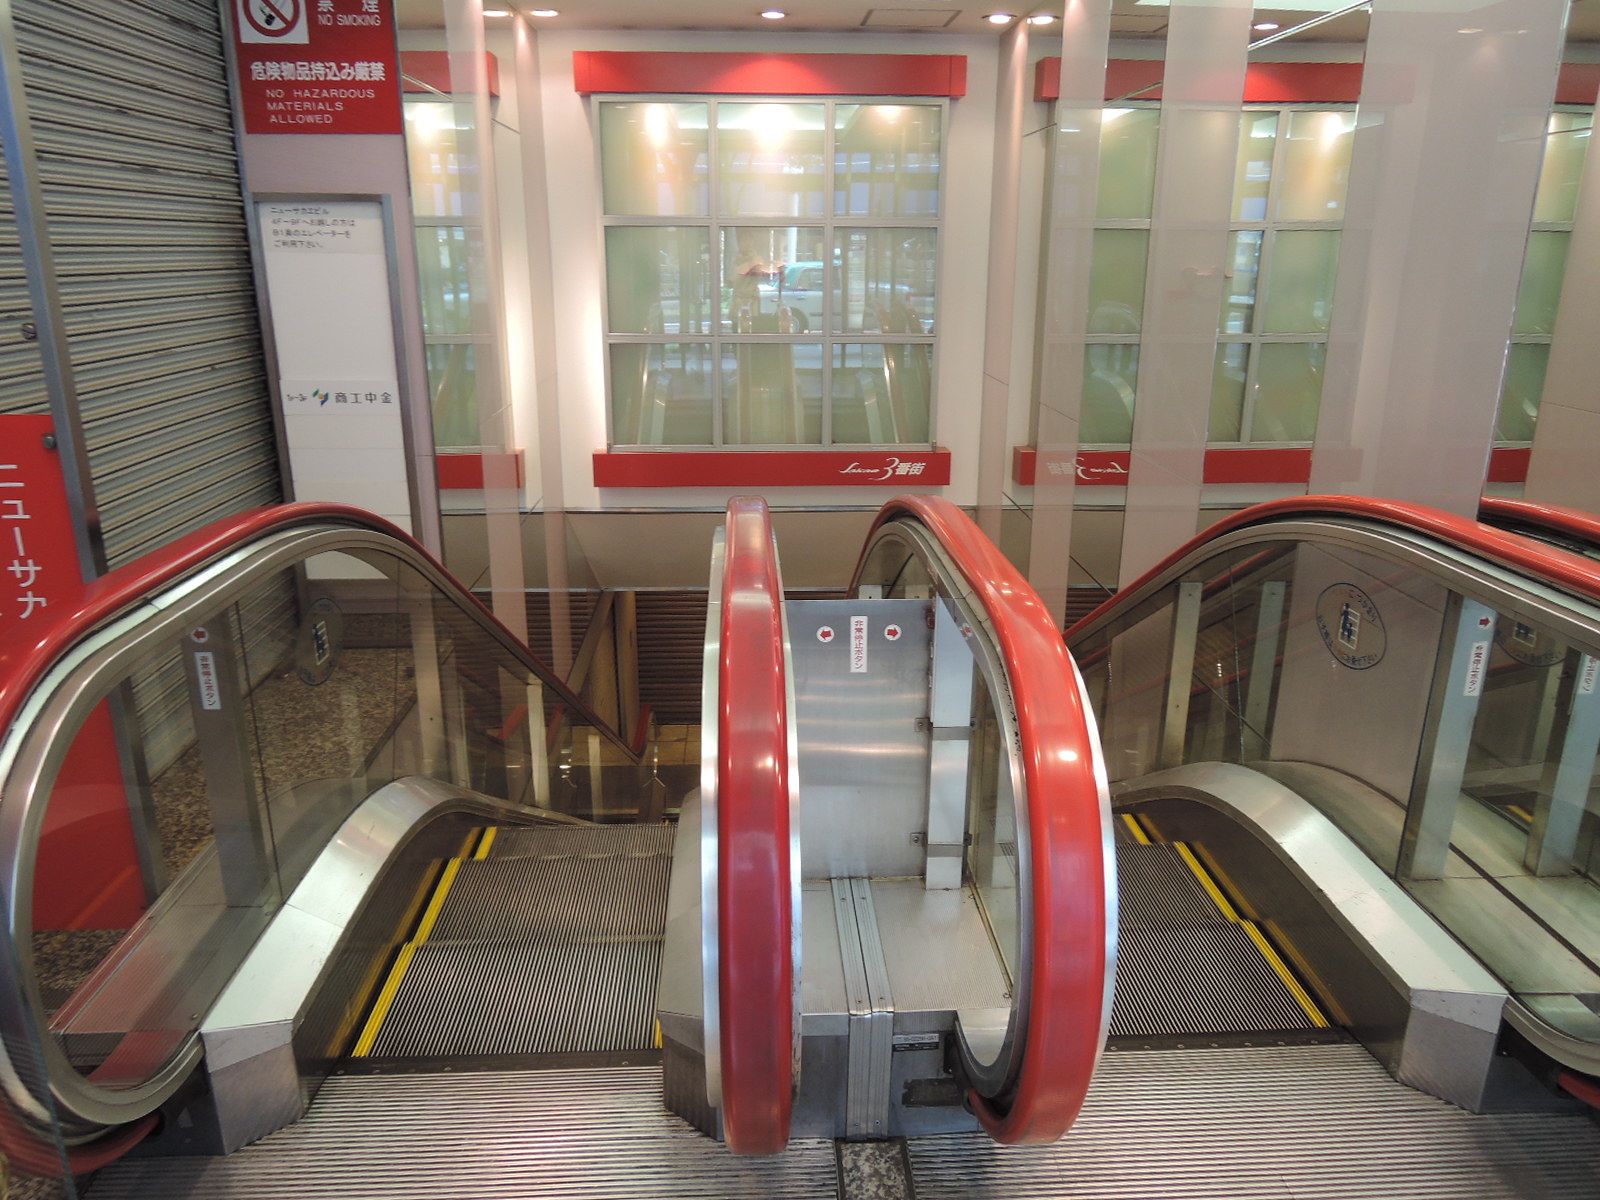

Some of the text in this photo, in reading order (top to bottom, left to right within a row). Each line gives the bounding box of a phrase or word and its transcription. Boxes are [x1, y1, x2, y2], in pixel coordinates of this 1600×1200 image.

[318, 14, 381, 26] NO SMOKING
[251, 61, 385, 81] 危険物品持込み厳禁
[266, 89, 375, 99] NO HAZARDOUS
[266, 102, 344, 111] MATERIALS
[270, 115, 333, 124] ALLOWED
[854, 619, 864, 670] 非常停止ボタン
